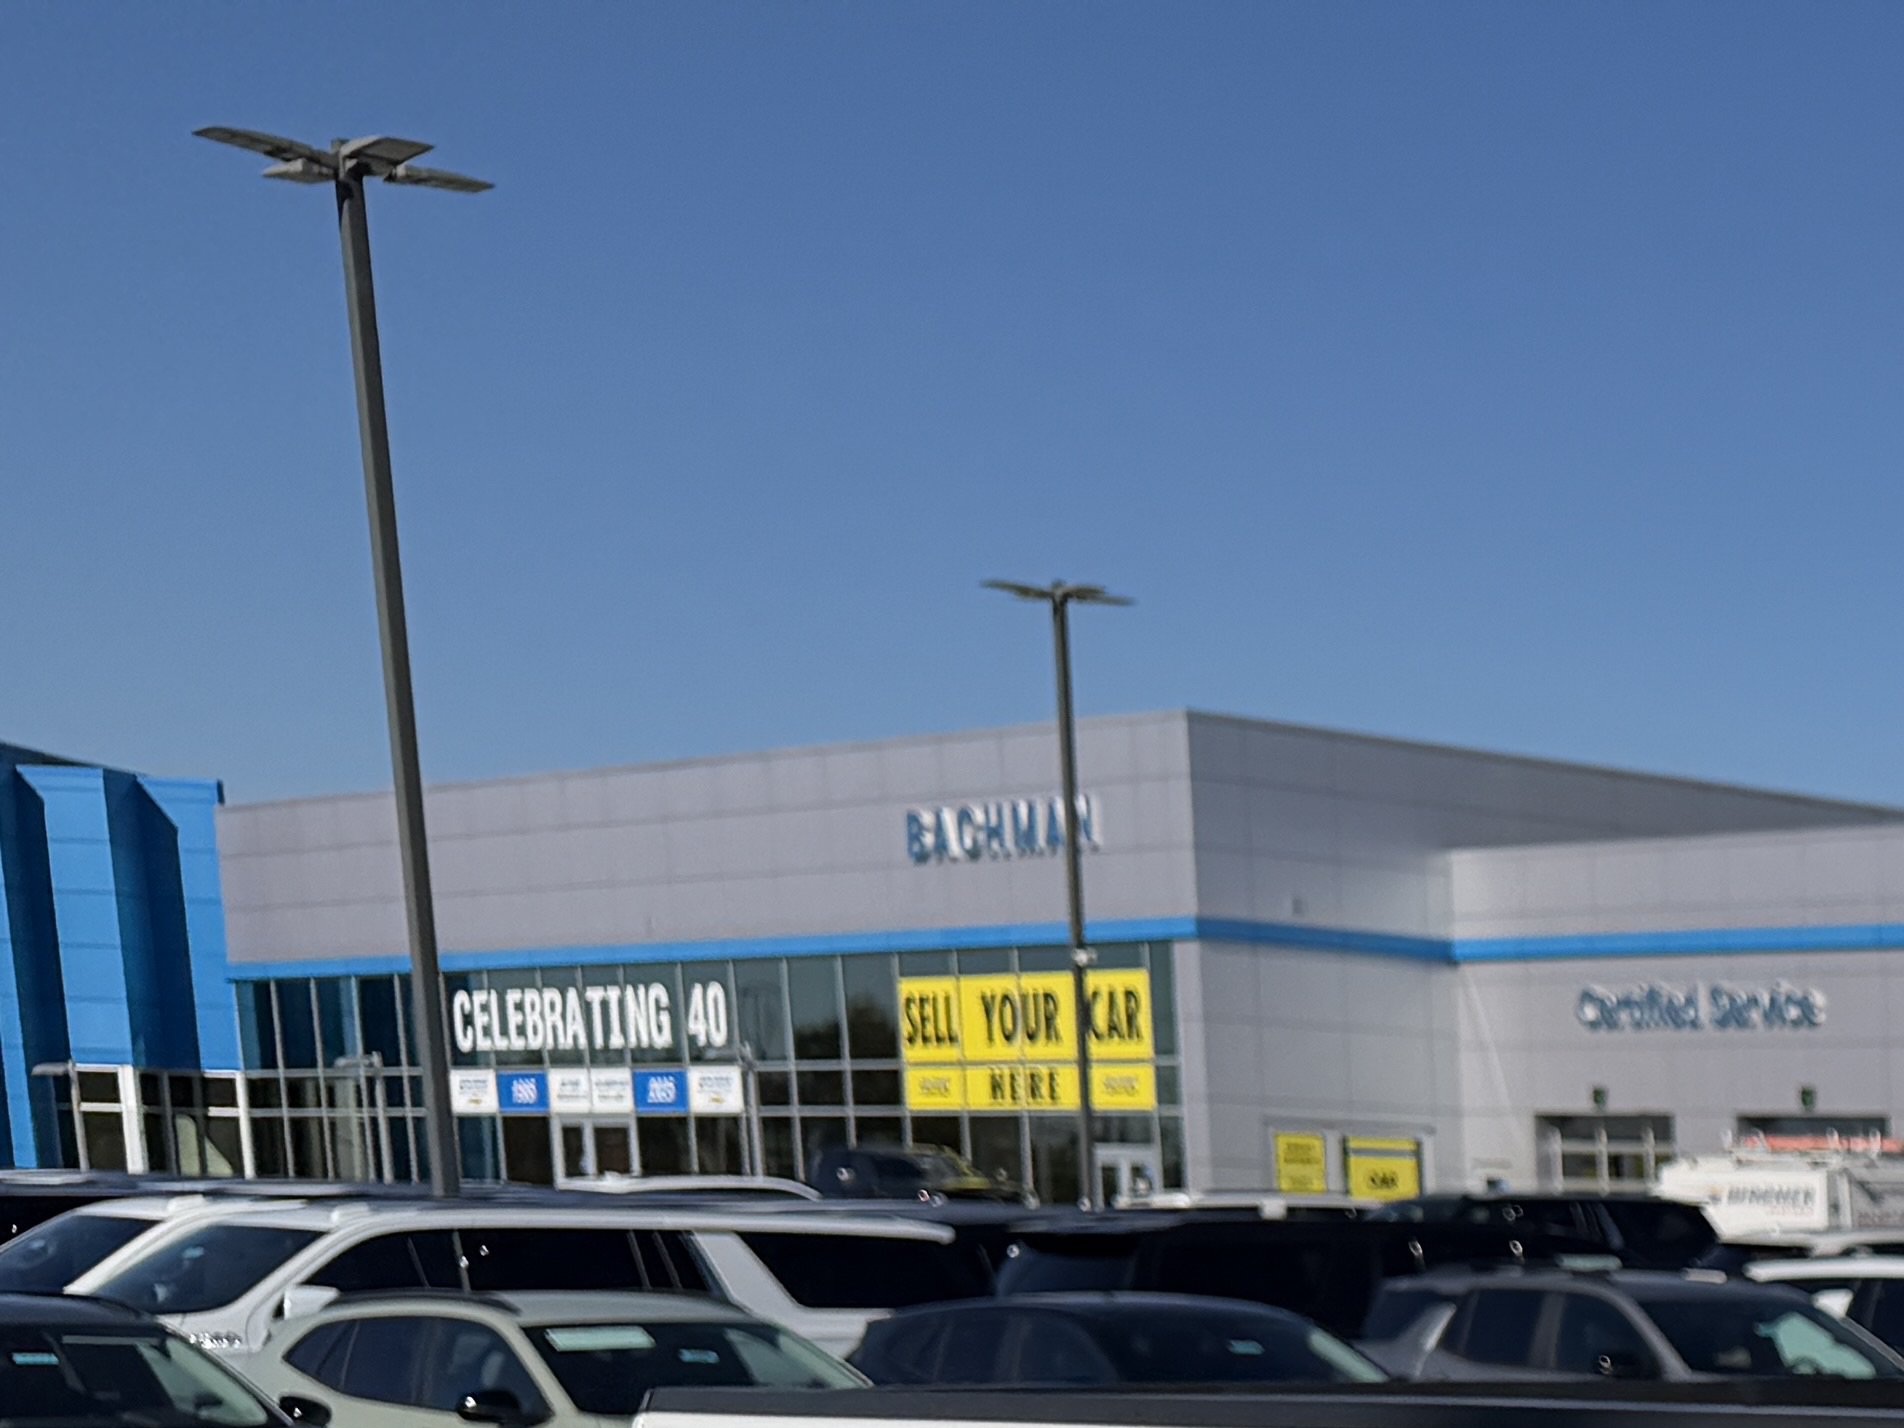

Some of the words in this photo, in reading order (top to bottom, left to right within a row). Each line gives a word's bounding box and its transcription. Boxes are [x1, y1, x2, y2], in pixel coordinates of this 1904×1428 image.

[906, 794, 1103, 863] BACHMAN
[452, 982, 673, 1053] CELEBRATING
[688, 981, 728, 1048] 40
[904, 991, 959, 1045] SELL
[981, 991, 1062, 1043] YOUR
[1088, 988, 1143, 1041] CAR
[1577, 982, 1703, 1030] Certified
[1710, 980, 1827, 1029] Service
[989, 1064, 1060, 1102] HERE
